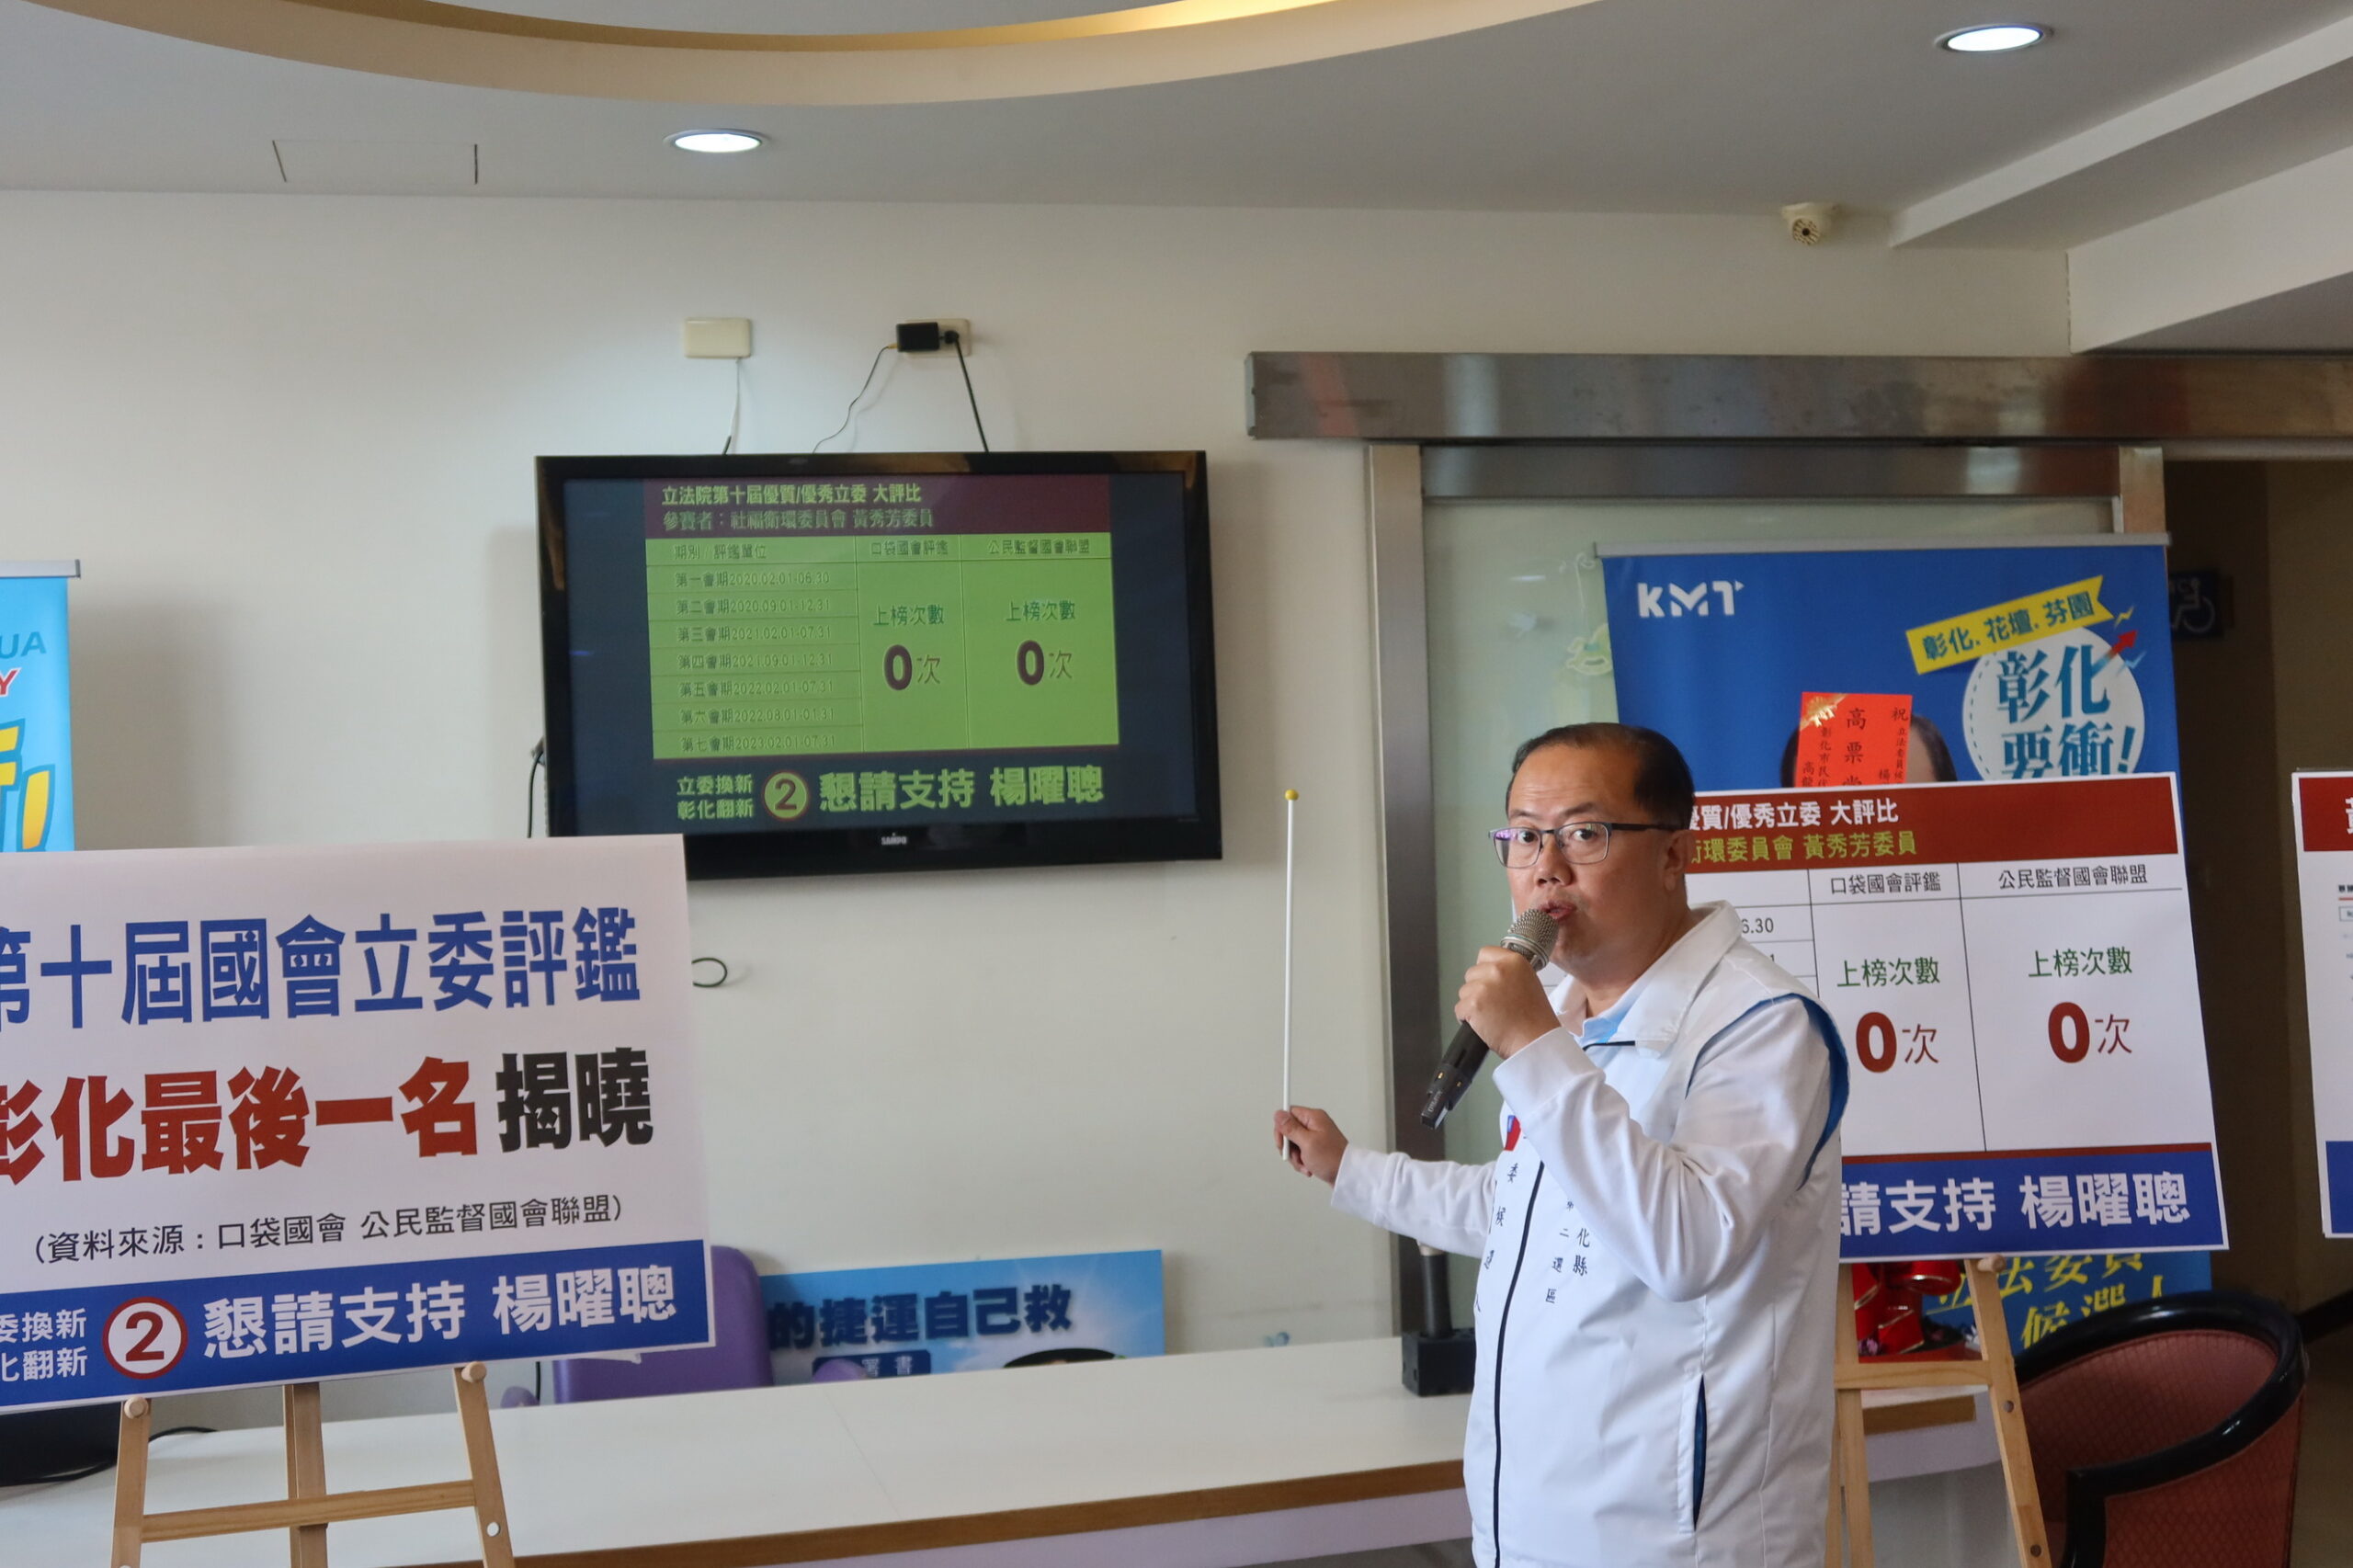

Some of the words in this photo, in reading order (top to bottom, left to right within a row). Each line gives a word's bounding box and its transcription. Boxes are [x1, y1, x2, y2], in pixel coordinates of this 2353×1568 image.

[662, 484, 866, 506] 立法院第十屆優質/優秀立委
[872, 483, 921, 503] 大評比
[988, 539, 1090, 555] 公民監督國會聯盟
[1006, 599, 1075, 622] 上榜次數
[1638, 580, 1735, 618] KMT
[874, 603, 945, 627] 上榜次數
[1997, 644, 2110, 724] 彰化
[676, 774, 754, 797] 立委換新
[820, 769, 975, 812] 懇請支持
[990, 765, 1104, 807] 楊曜聰
[677, 798, 755, 820] 彰化翻新
[1830, 798, 1899, 826] 大評比
[1803, 831, 1917, 860] 黃秀芳委員
[1831, 872, 1941, 894] 口袋國會評鑑
[1998, 865, 2148, 890] 公民監督國會聯盟
[1836, 956, 1940, 987] 上榜次數
[2028, 947, 2132, 978] 上榜次數
[495, 1047, 654, 1153] 揭曉
[2019, 1171, 2190, 1230] 楊曜聰
[360, 1195, 622, 1240] 公民監督國會聯盟)
[204, 1280, 466, 1358] 懇請支持
[492, 1265, 676, 1335] 楊曜聰
